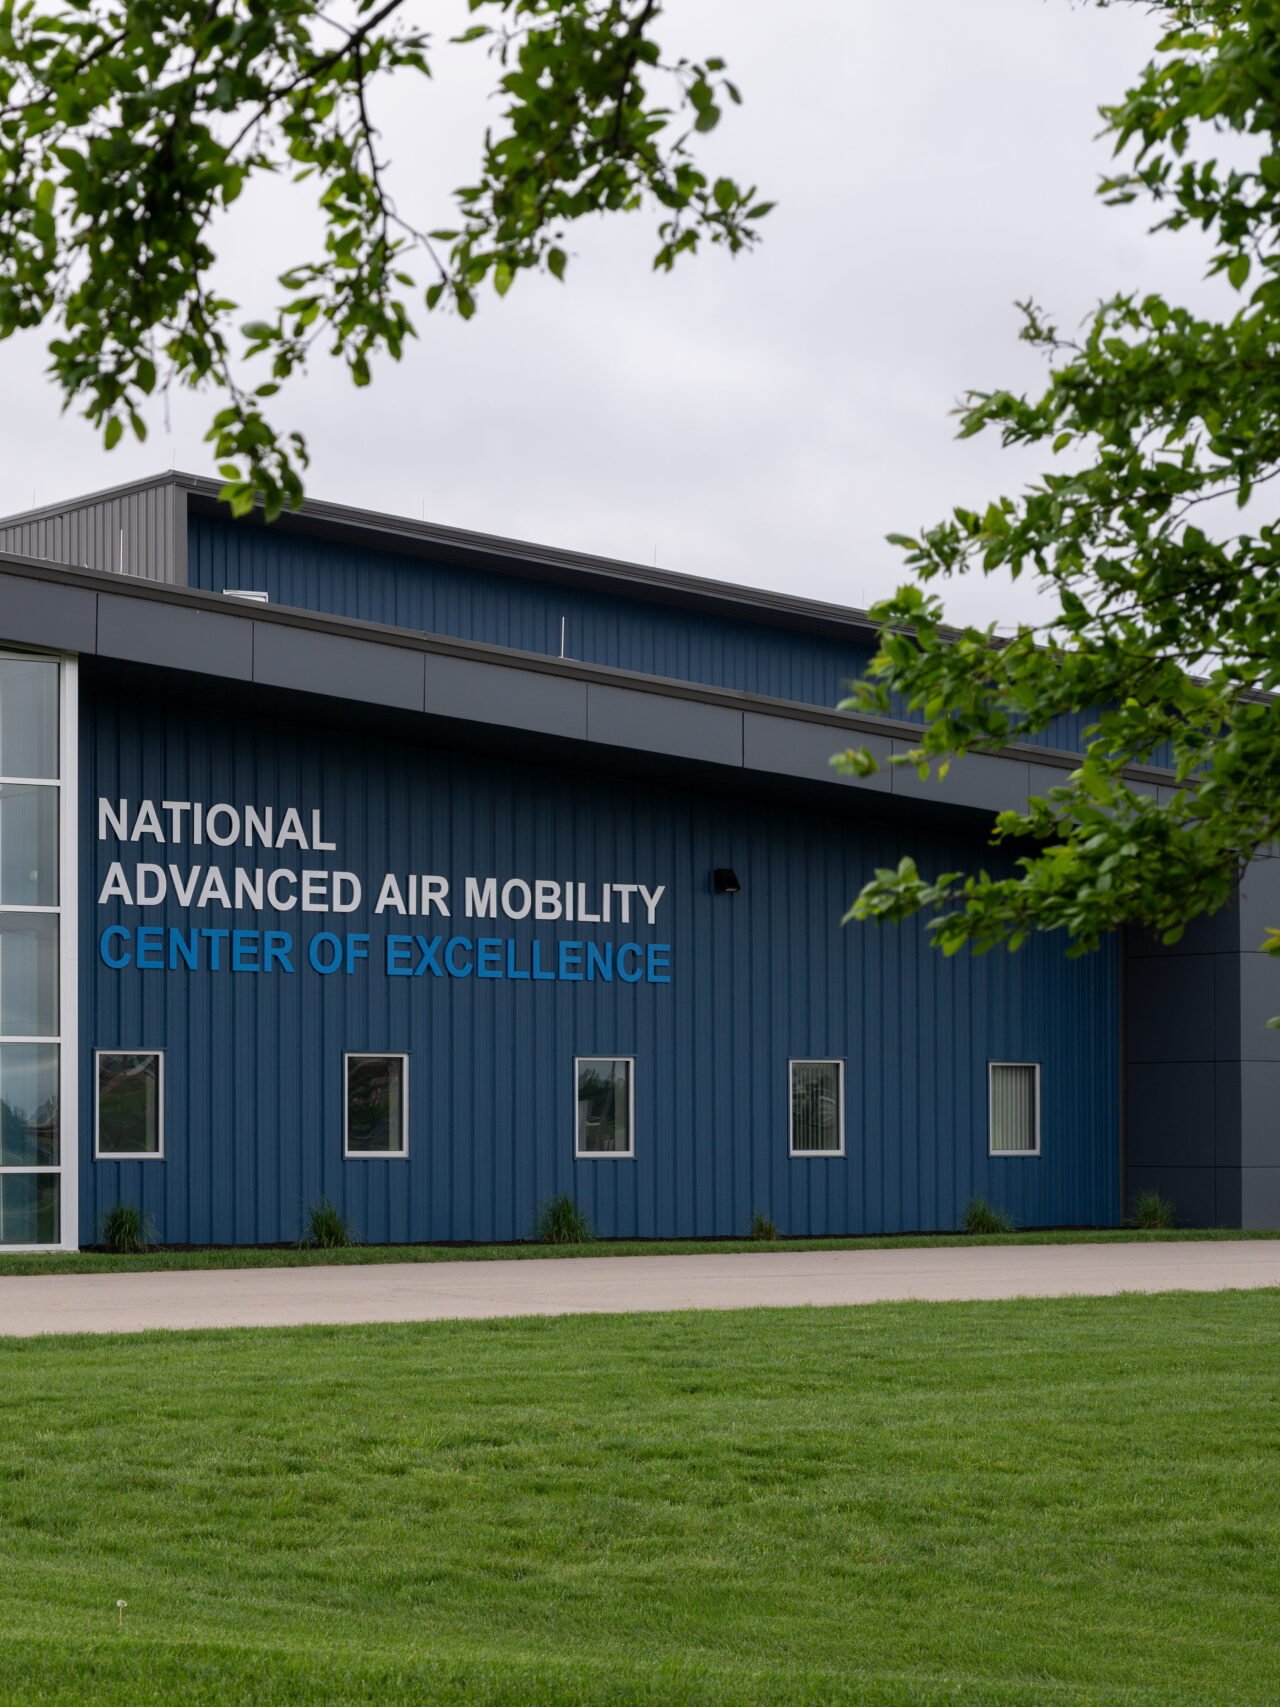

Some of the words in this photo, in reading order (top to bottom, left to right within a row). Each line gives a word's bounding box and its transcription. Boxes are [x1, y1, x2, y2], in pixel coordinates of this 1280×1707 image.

[98, 797, 337, 851] NATIONAL
[98, 861, 362, 913] ADVANCED
[374, 873, 451, 917] AIR
[465, 877, 666, 925] MOBILITY
[99, 925, 295, 973] CENTER
[309, 931, 371, 974] OF
[386, 934, 671, 983] EXCELLENCE
